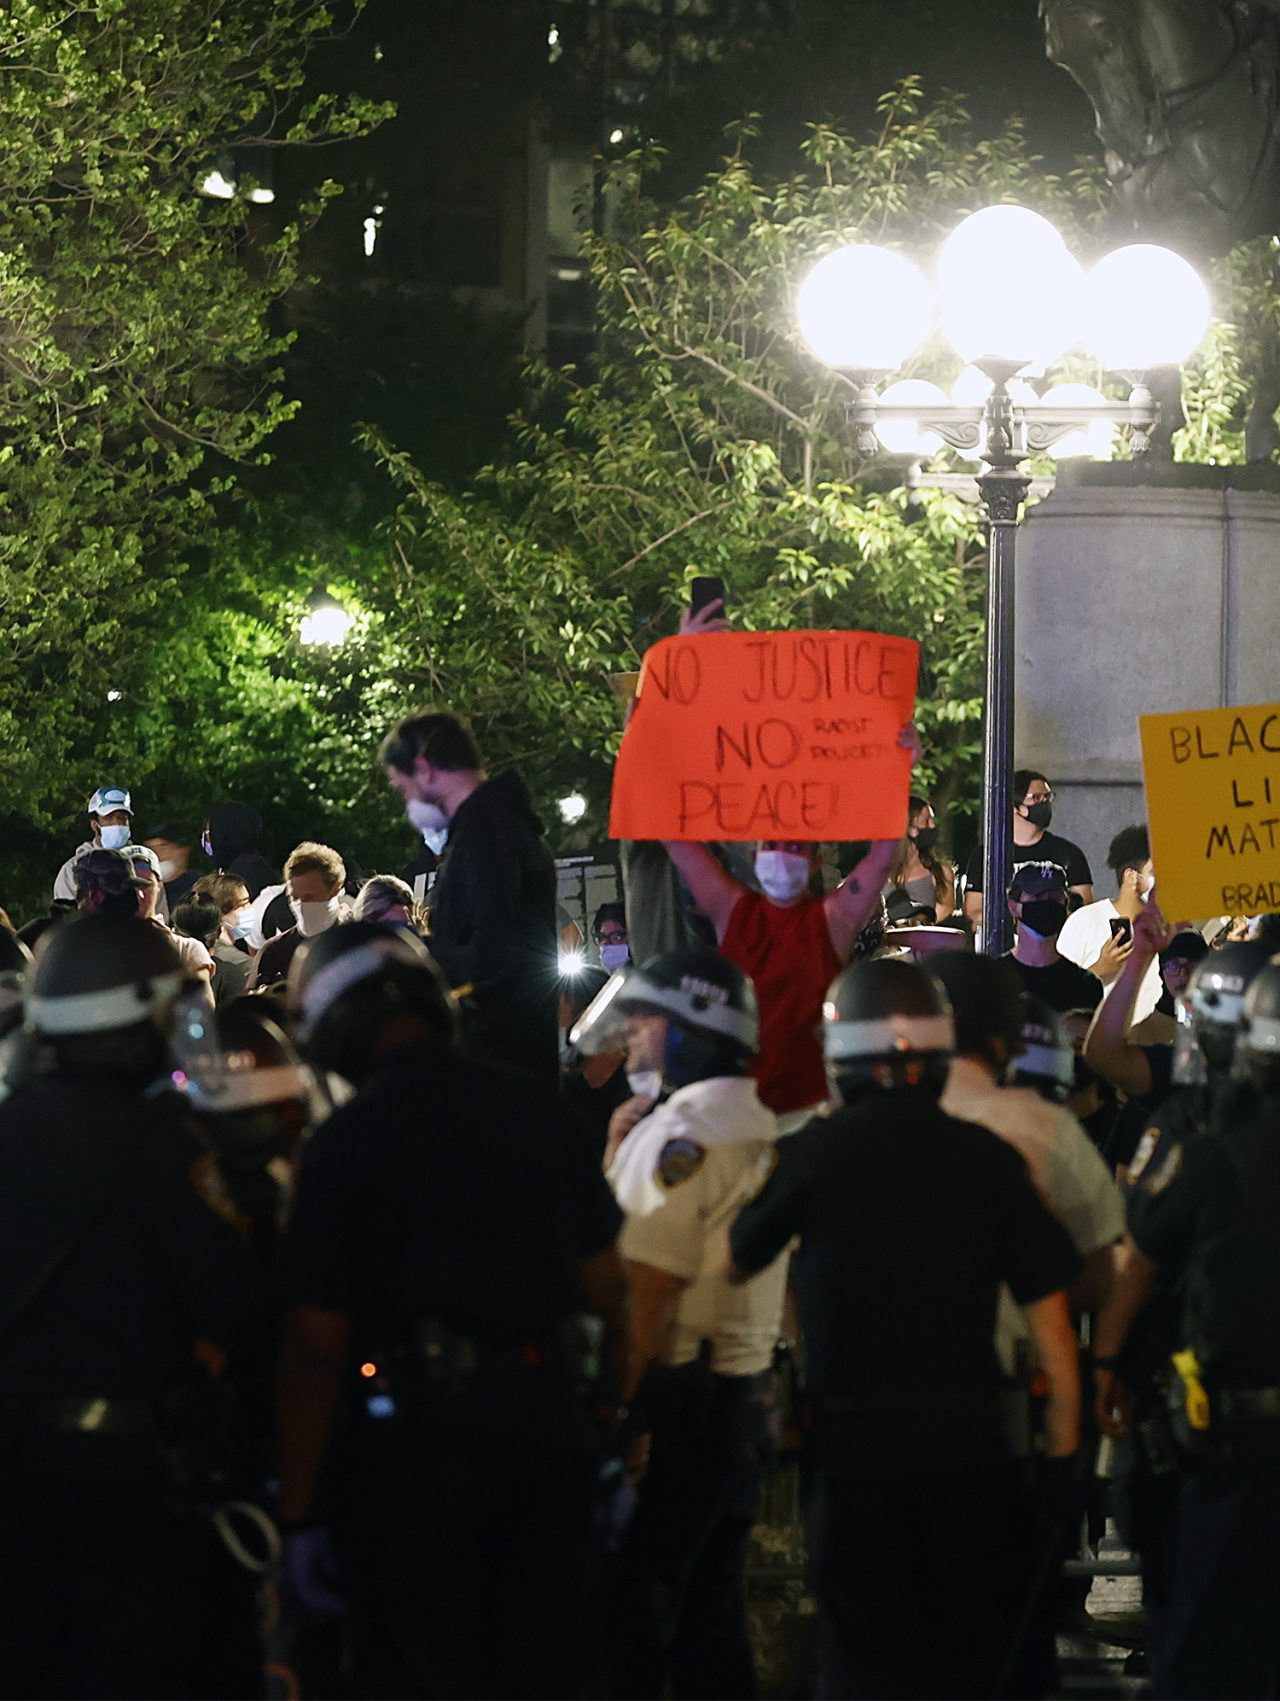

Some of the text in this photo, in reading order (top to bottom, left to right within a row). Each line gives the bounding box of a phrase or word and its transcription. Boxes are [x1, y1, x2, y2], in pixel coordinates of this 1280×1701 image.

[648, 636, 908, 705] NO JUSTICE
[715, 717, 800, 771] NO
